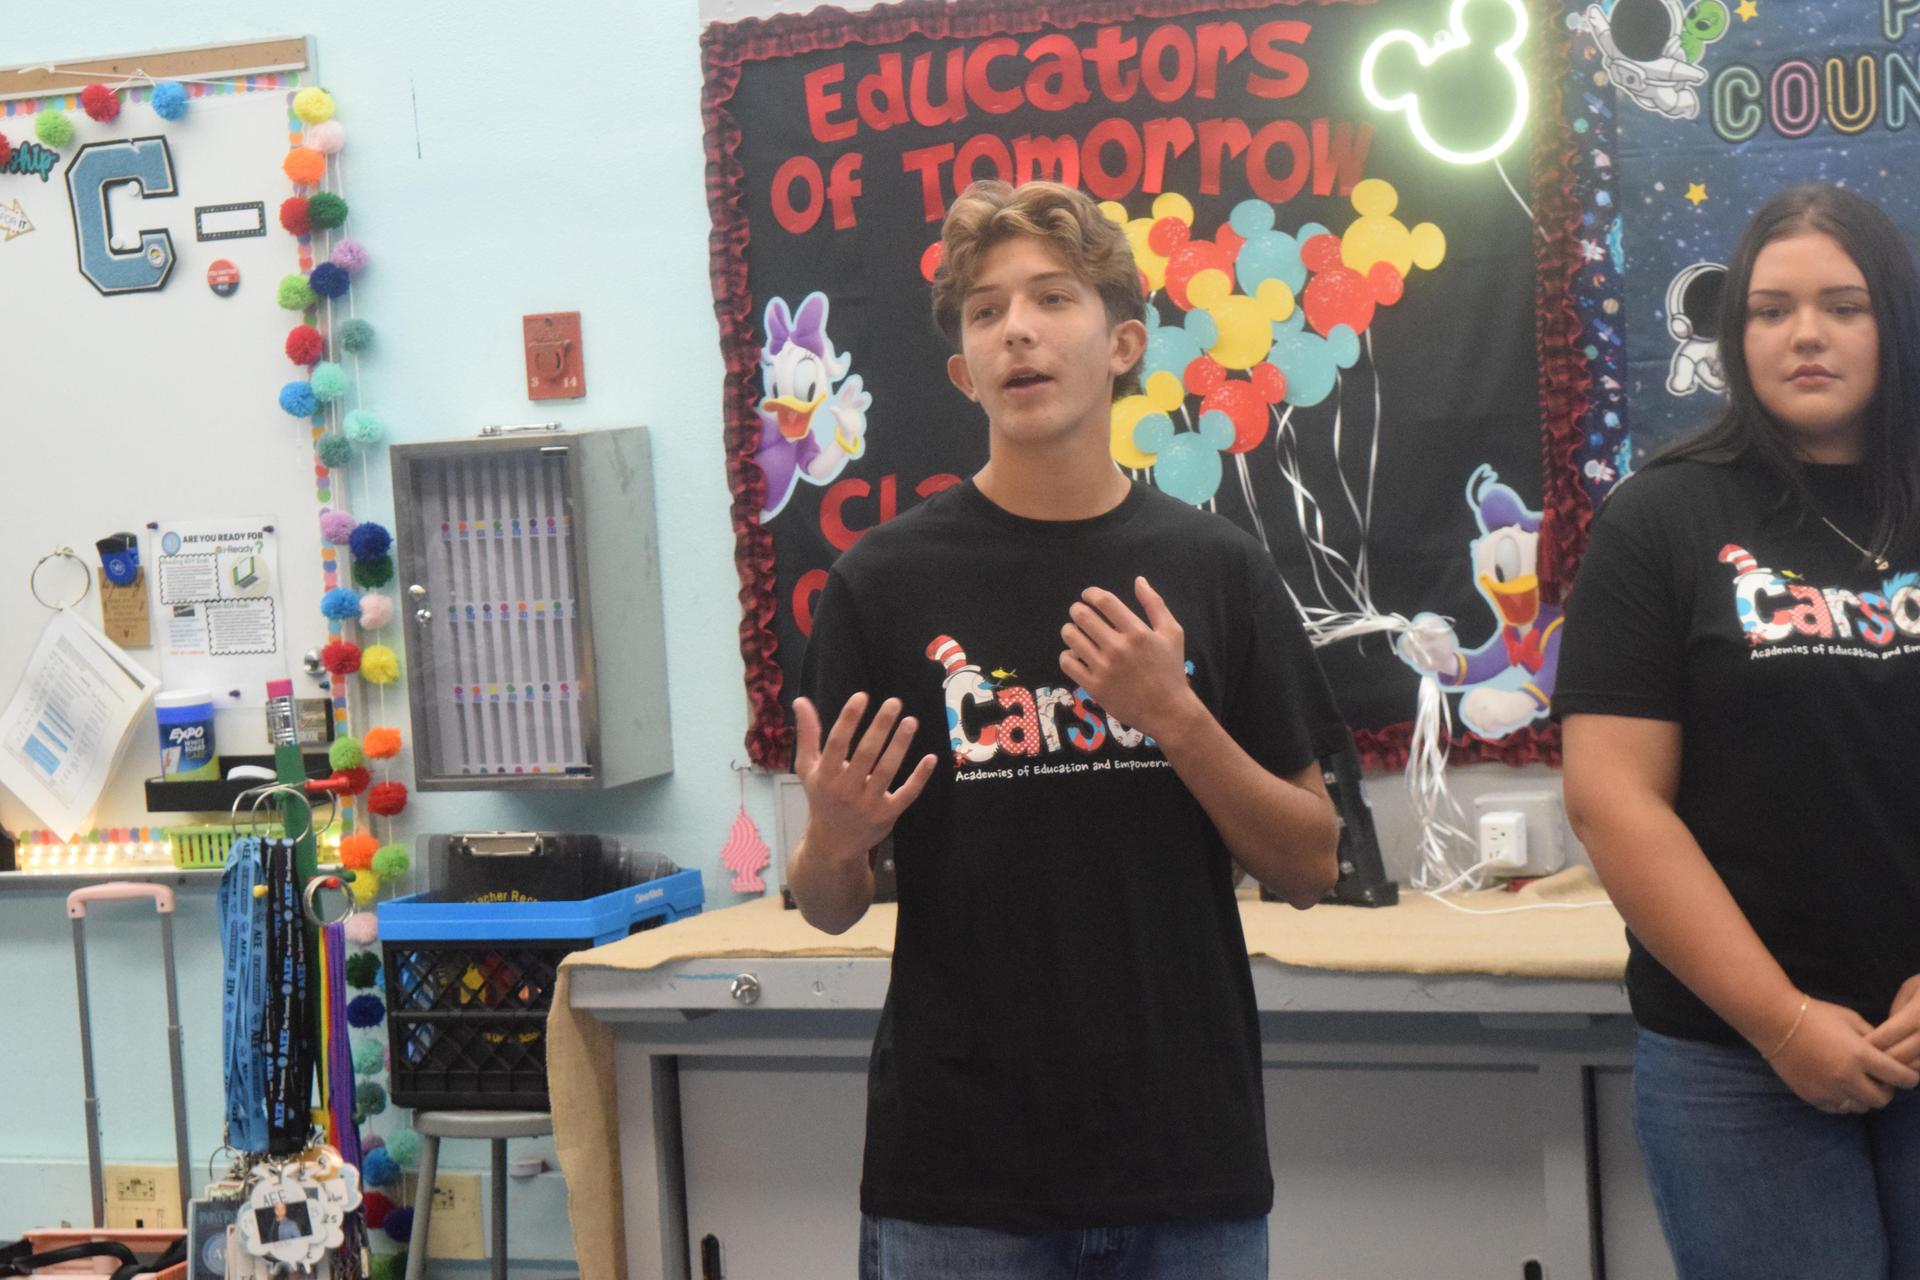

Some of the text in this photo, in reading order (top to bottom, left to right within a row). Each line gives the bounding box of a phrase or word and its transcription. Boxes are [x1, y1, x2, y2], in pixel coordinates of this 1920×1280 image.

[804, 20, 1312, 143] Educators
[1713, 53, 1920, 141] COUN
[0, 141, 60, 182] ship
[770, 117, 1376, 234] Of Tomorrow
[183, 531, 264, 543] ARE YOU READY FOR
[1736, 571, 1920, 645] Carso
[1750, 645, 1809, 660] Academies
[1812, 643, 1825, 655] of
[1828, 644, 1880, 659] Education
[1881, 646, 1901, 660] and
[169, 726, 204, 744] EXPO
[945, 668, 1158, 763] Cars
[955, 769, 1013, 782] Academies
[1017, 765, 1030, 777] of
[1033, 762, 1089, 775] Education
[1093, 759, 1111, 770] and
